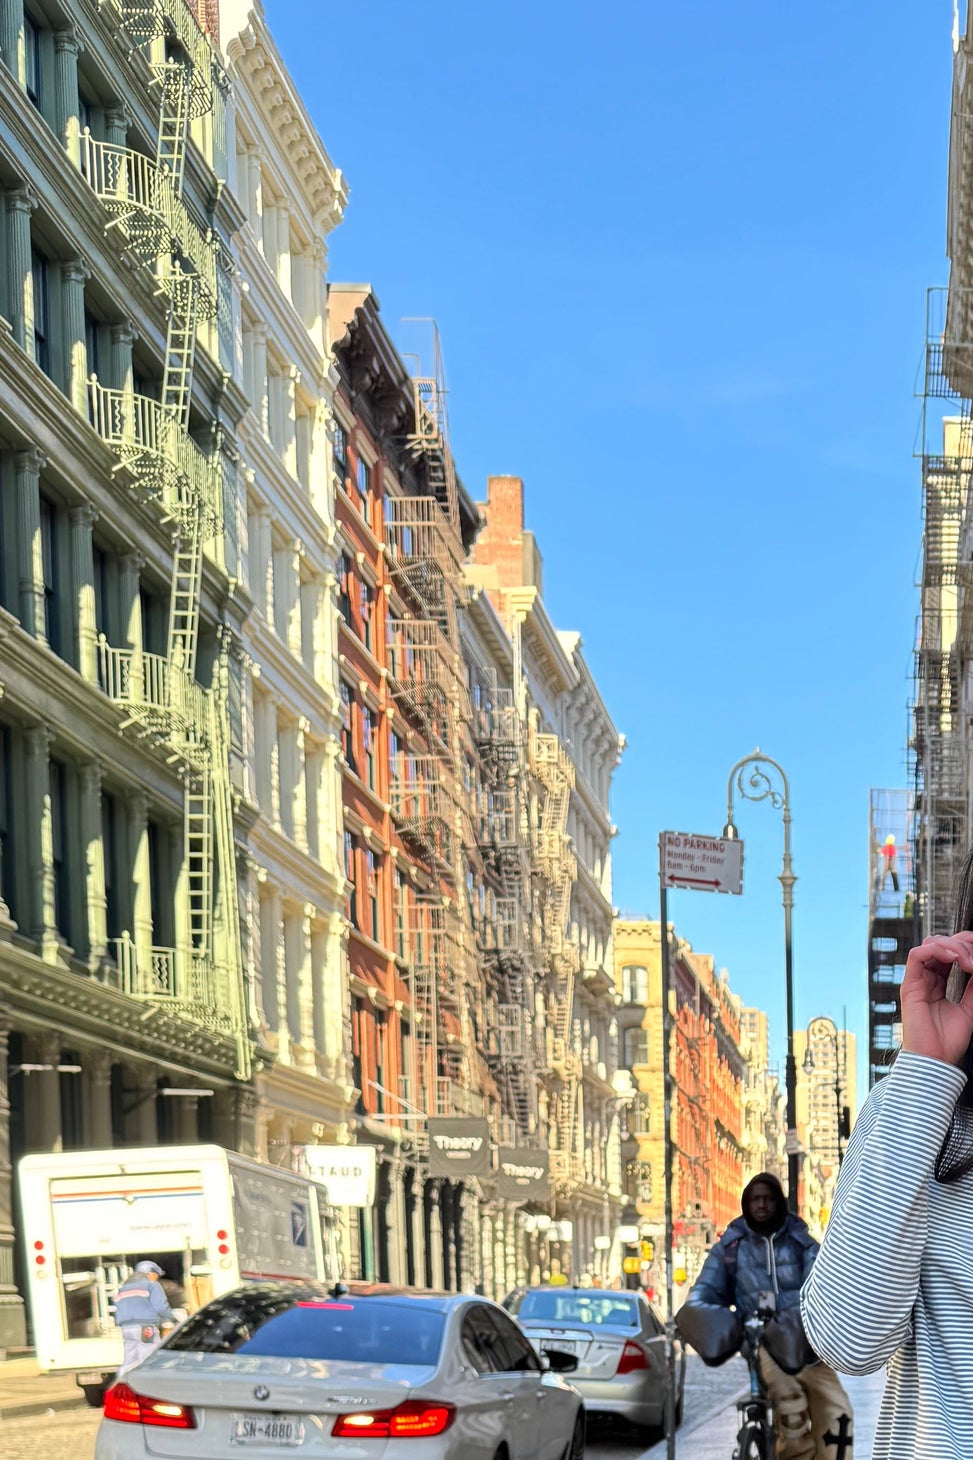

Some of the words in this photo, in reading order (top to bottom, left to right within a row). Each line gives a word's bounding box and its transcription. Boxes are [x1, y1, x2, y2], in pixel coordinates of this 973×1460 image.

[667, 837, 681, 847] NO
[683, 838, 726, 853] PARKING
[667, 850, 695, 862] Monday
[702, 854, 726, 866] Friday
[433, 1135, 482, 1151] Theory
[310, 1166, 362, 1177] TAUD
[501, 1162, 544, 1180] Theory
